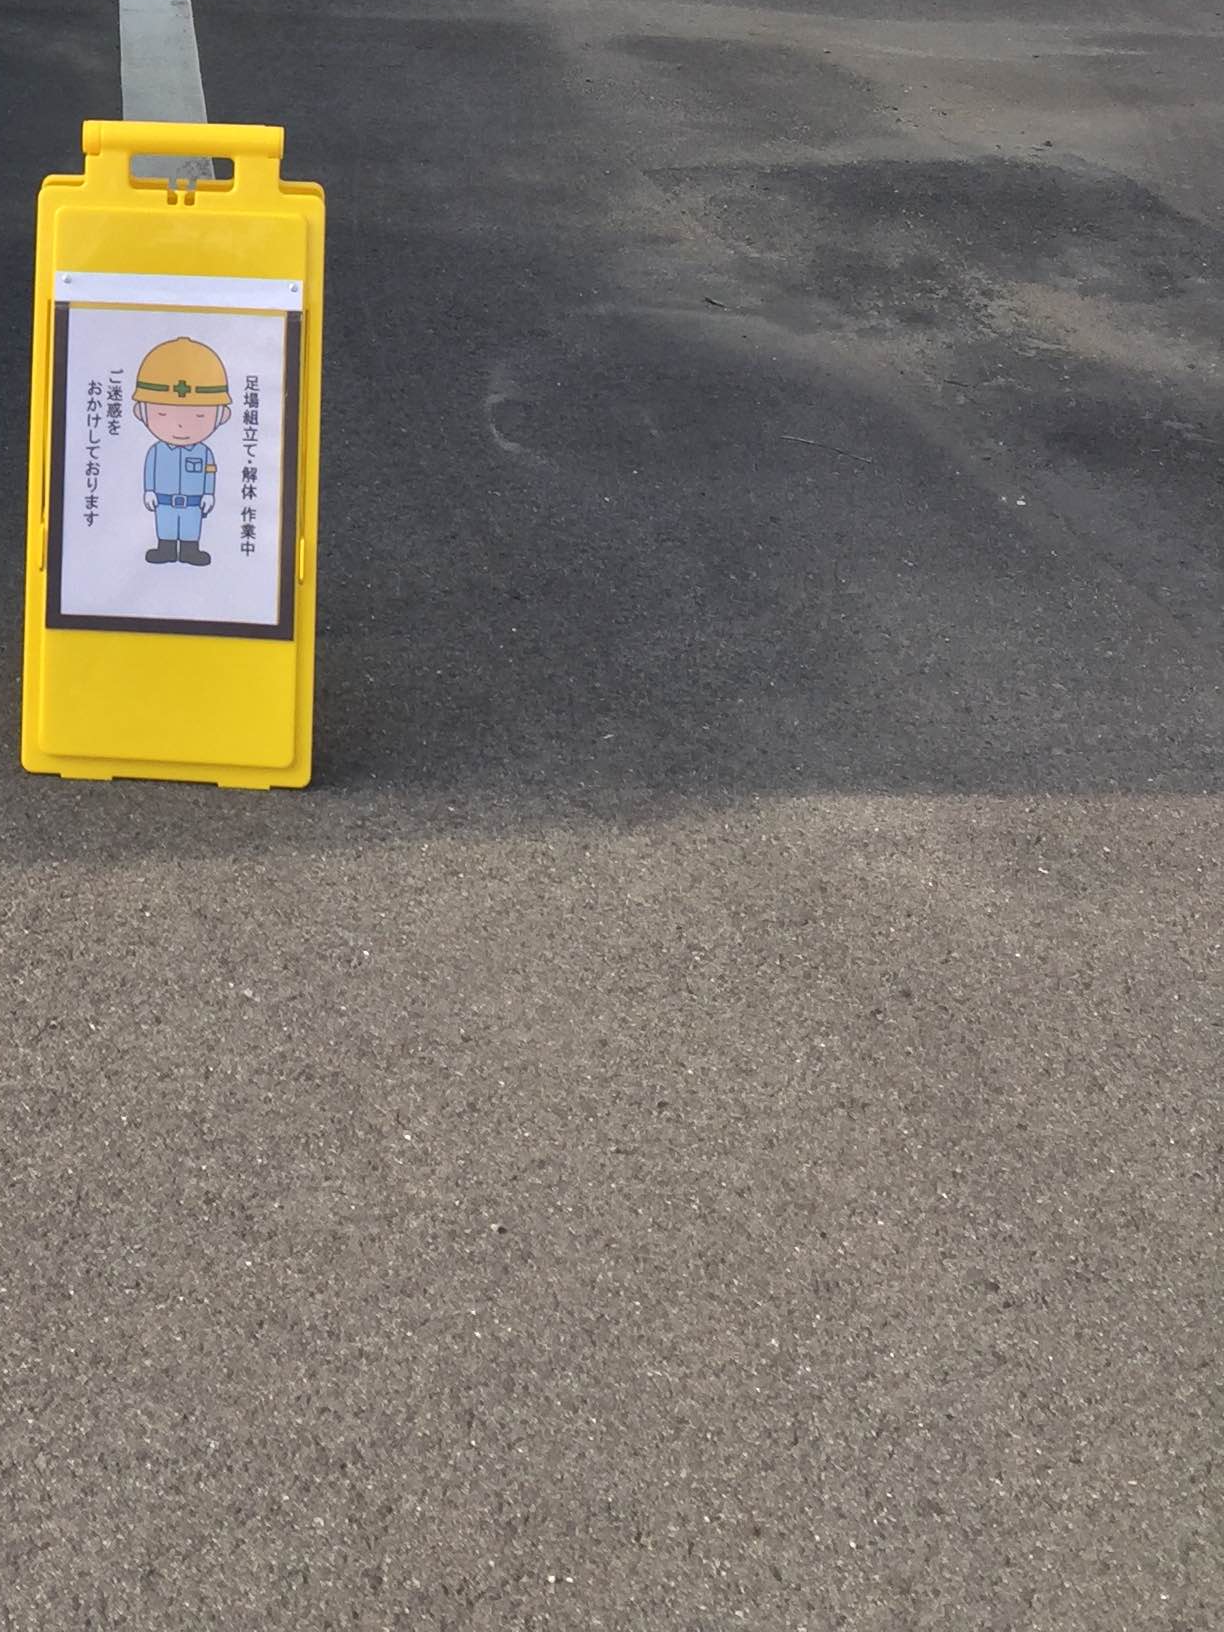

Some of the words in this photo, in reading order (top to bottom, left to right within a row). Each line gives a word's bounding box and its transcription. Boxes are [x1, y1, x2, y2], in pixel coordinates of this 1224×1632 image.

[105, 368, 124, 437] ご迷惑を
[240, 374, 261, 501] 足場組立て・解体
[82, 379, 103, 528] おかけしております
[239, 506, 258, 557] 作業中
